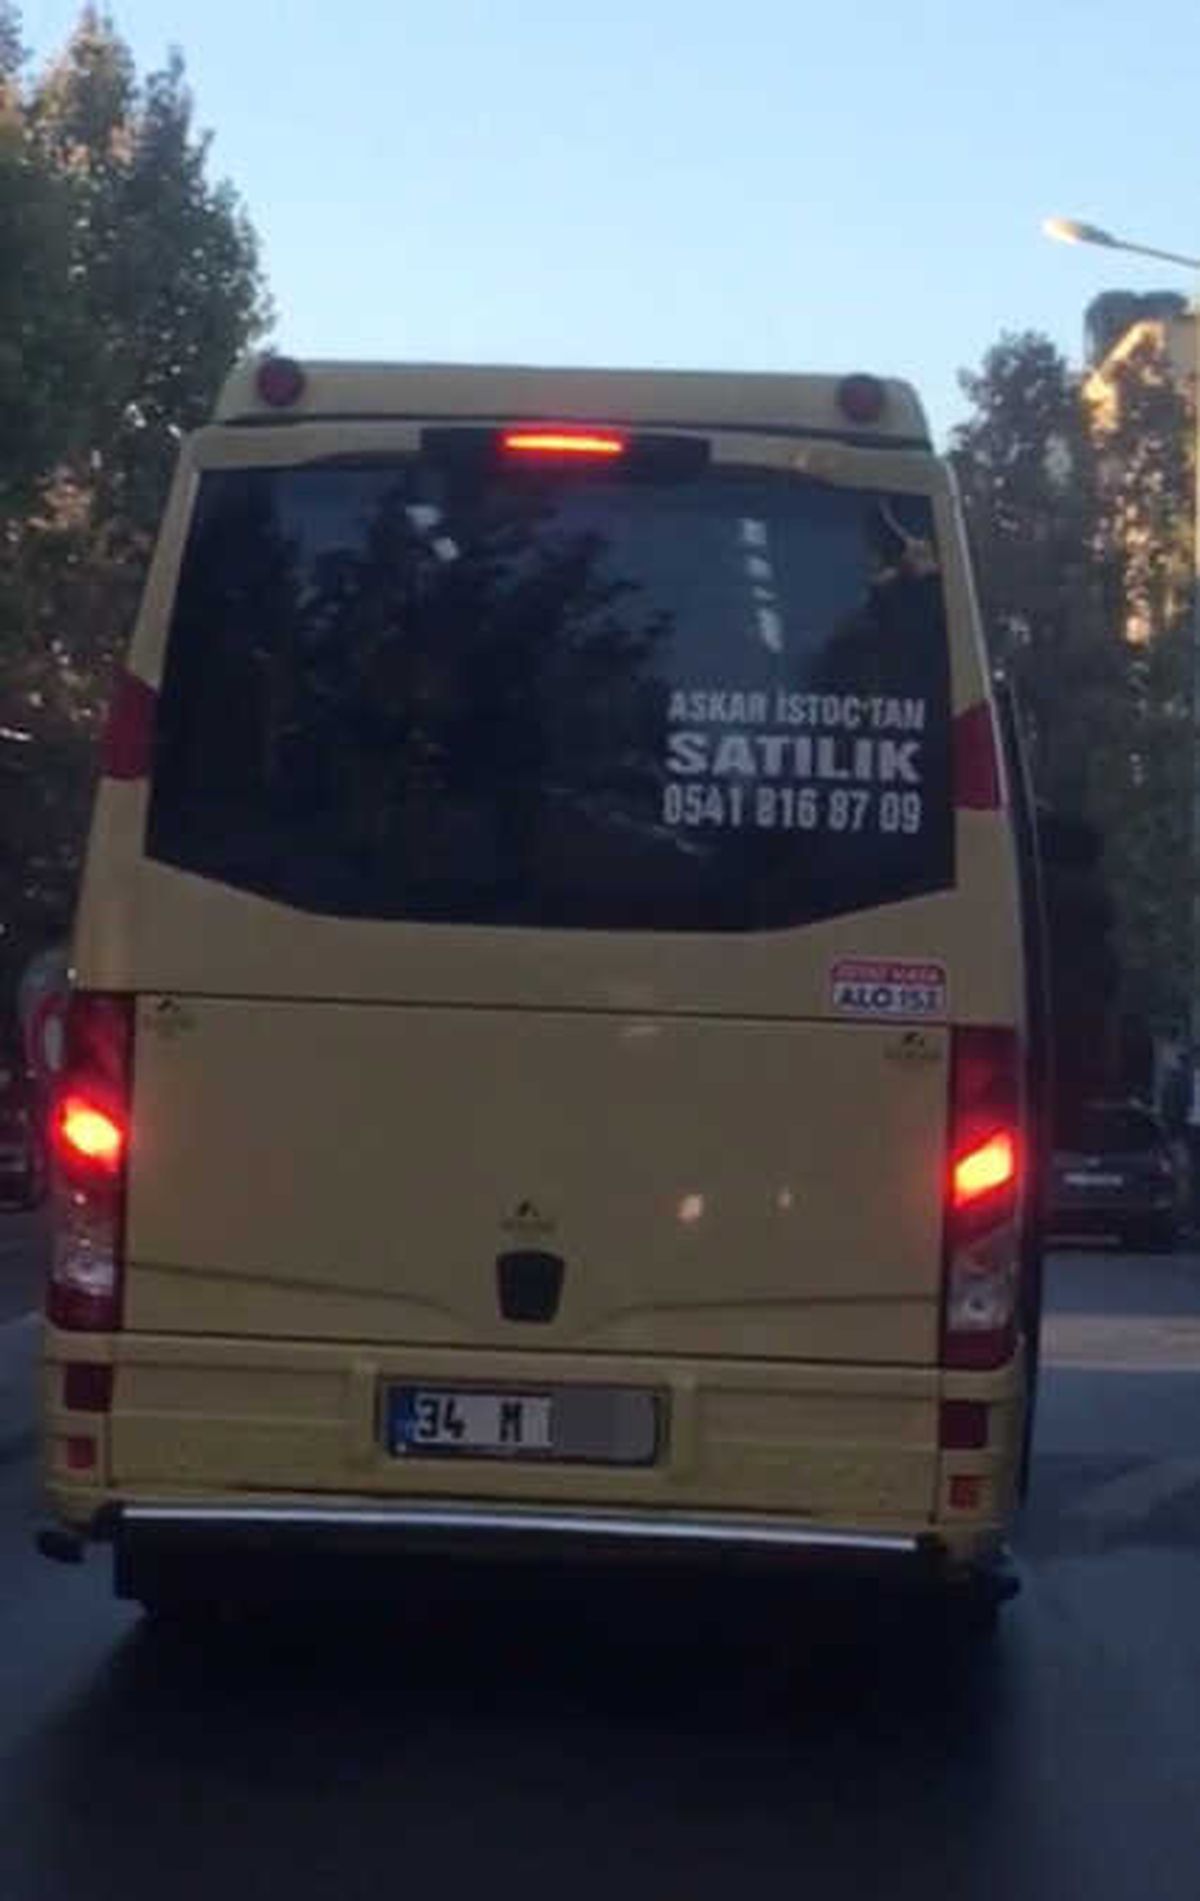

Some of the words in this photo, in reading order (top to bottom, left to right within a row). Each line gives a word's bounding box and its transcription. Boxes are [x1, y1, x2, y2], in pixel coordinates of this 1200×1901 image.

[665, 732, 921, 782] SATILIK
[663, 783, 743, 827] 0541
[756, 787, 818, 829] 816
[827, 789, 870, 831] 87
[879, 791, 922, 834] 09
[839, 986, 893, 1009] ALO
[418, 1398, 466, 1440] 34
[500, 1401, 523, 1442] M
